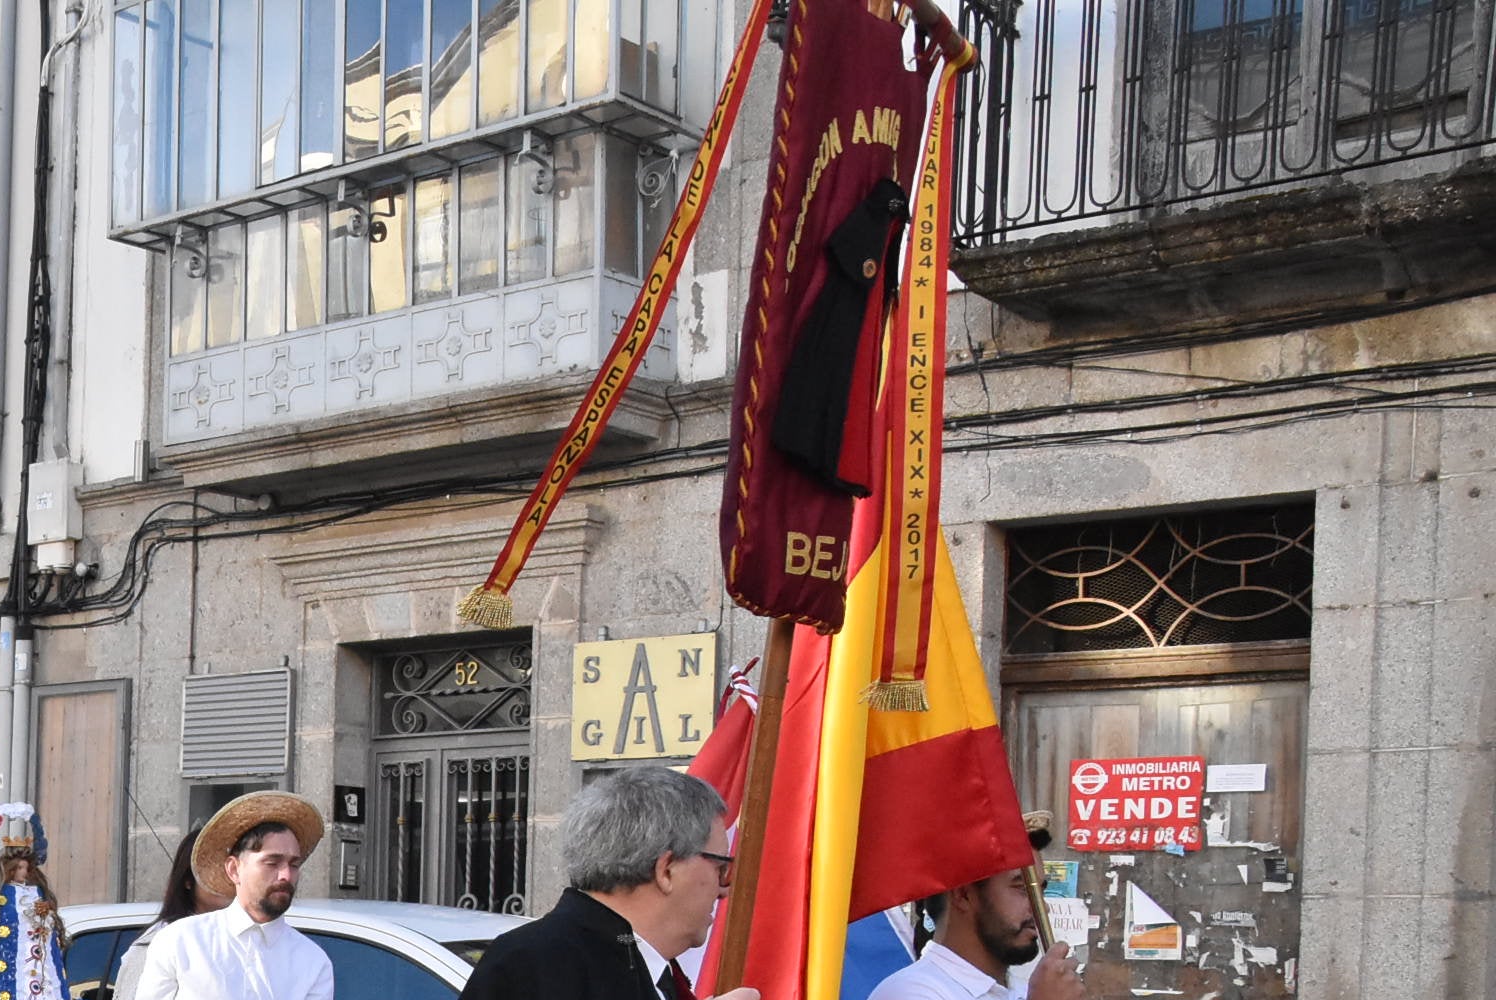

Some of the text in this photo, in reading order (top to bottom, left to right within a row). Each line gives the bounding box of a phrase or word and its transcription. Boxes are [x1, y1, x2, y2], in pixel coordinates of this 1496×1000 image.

[687, 160, 704, 206] DE
[659, 216, 682, 263] LA
[918, 203, 934, 269] 1984
[621, 274, 663, 358] CAPA
[909, 429, 925, 480] XIX
[906, 513, 921, 580] 2017
[455, 661, 479, 686] 52
[582, 643, 703, 754] SAN
[581, 714, 701, 746] GIL
[1112, 761, 1201, 776] INMOBILIARIA
[1121, 775, 1191, 792] METRO
[1075, 796, 1197, 821] VENDE
[1097, 826, 1199, 845] 923 41 08 43
